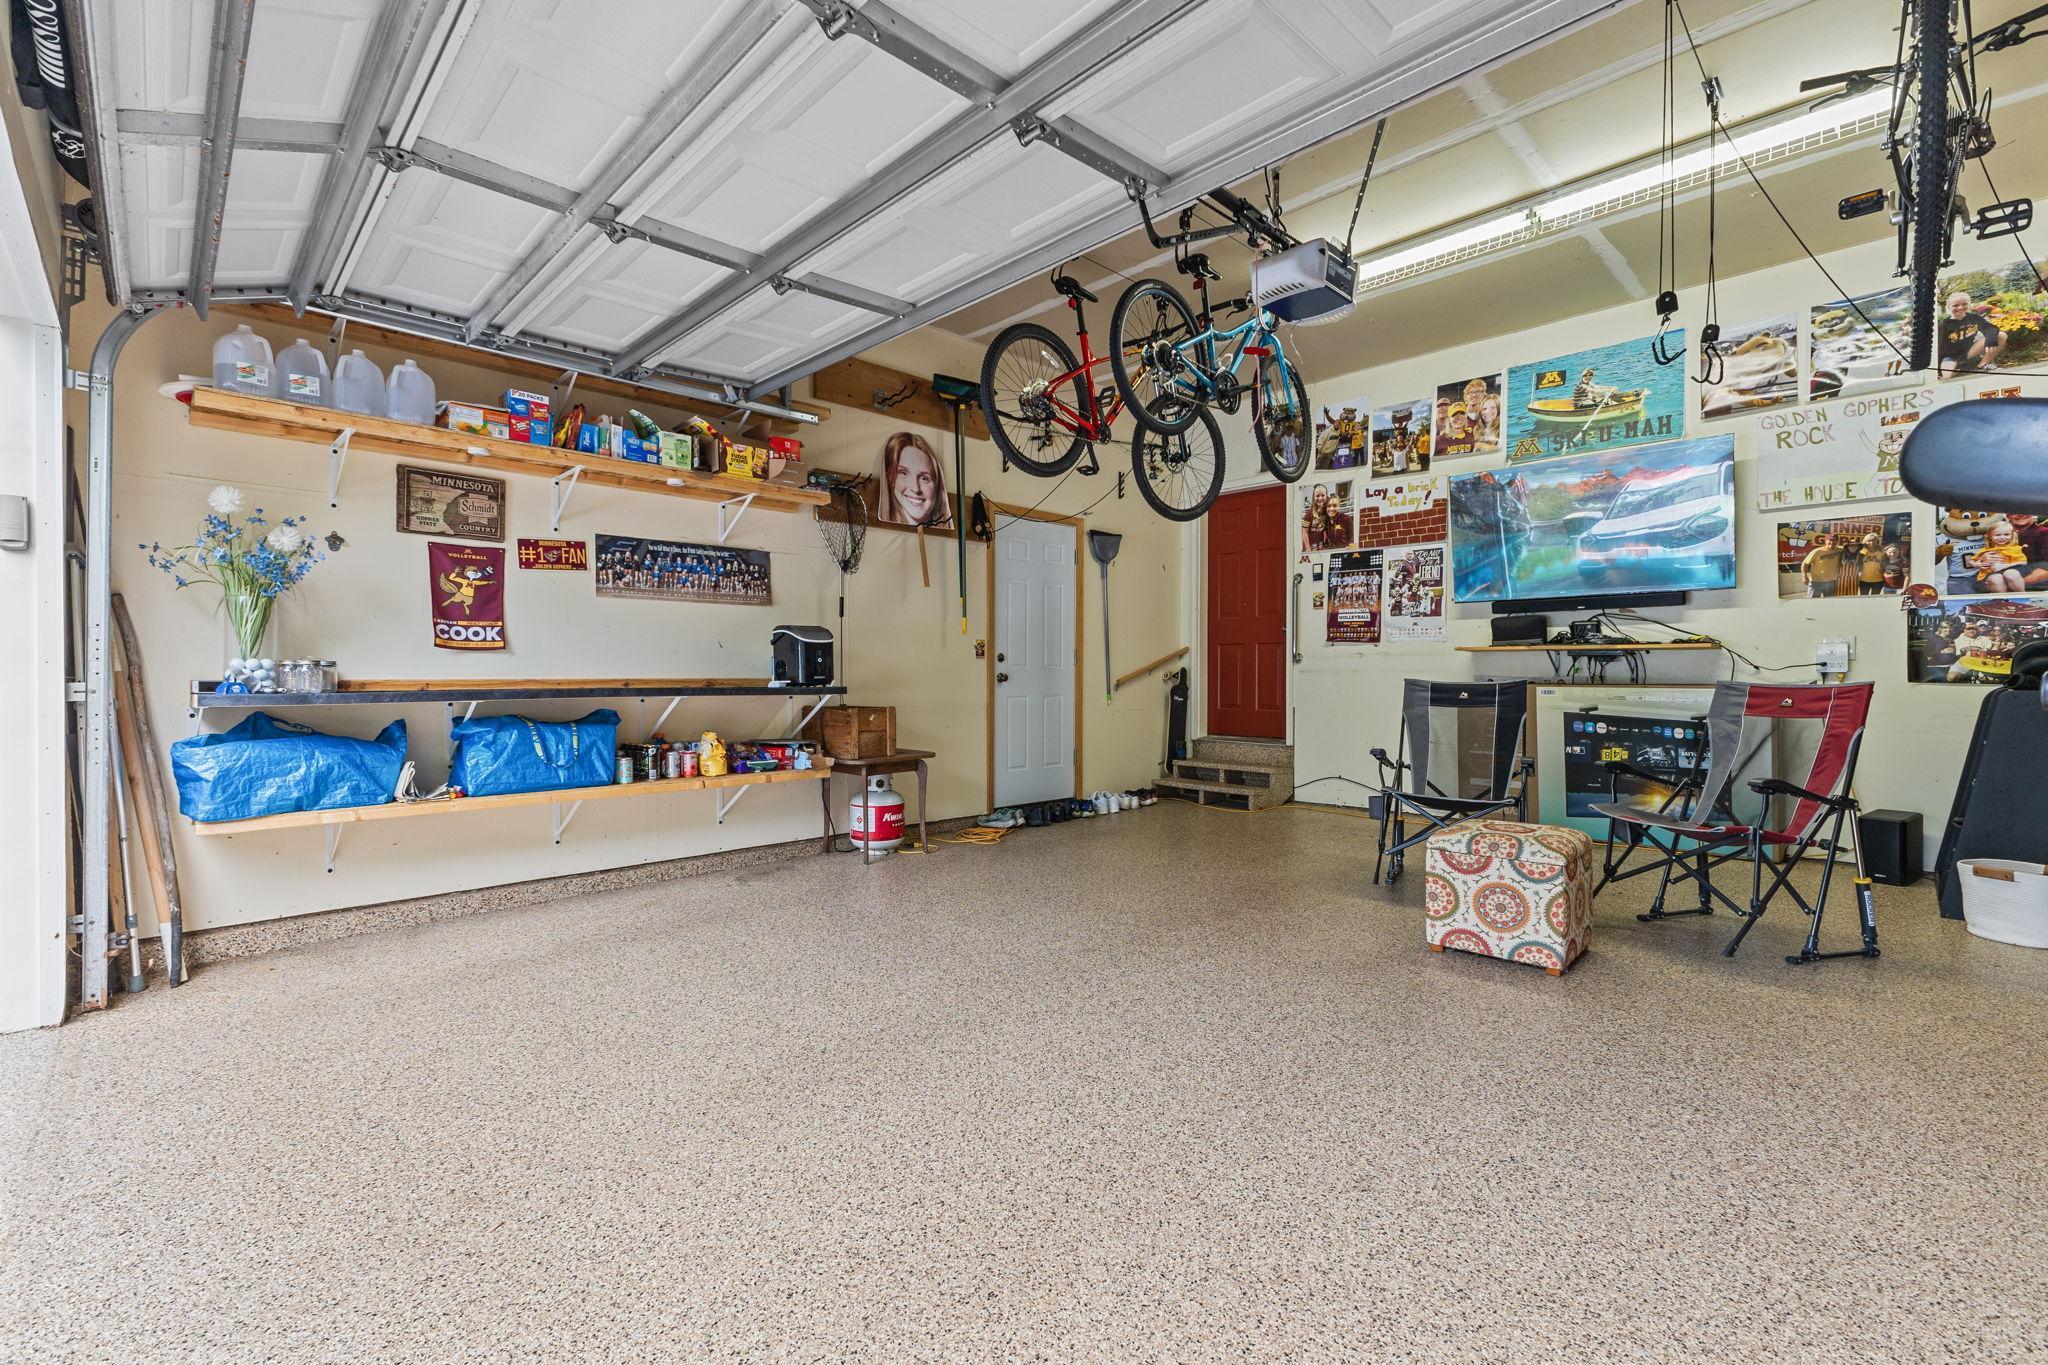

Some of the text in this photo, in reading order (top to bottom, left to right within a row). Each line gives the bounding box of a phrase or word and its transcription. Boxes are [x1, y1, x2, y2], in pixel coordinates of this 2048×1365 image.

[526, 393, 544, 402] PACKS
[1761, 389, 1934, 430] GOLDEN GOPHERS
[1776, 424, 1837, 449] ROCK
[431, 476, 495, 493] MINNESOTA
[1365, 488, 1388, 500] Lay
[1394, 486, 1404, 494] a
[1760, 489, 1792, 508] THE
[1804, 482, 1858, 502] HOUSE
[461, 499, 495, 514] Schmidt
[460, 524, 496, 533] COUNTRY
[1833, 522, 1882, 533] INNER
[520, 546, 586, 564] #1 FAN
[1958, 543, 1986, 552] MINNESO
[448, 552, 488, 560] VOLLEYBALL
[435, 624, 502, 641] COOK
